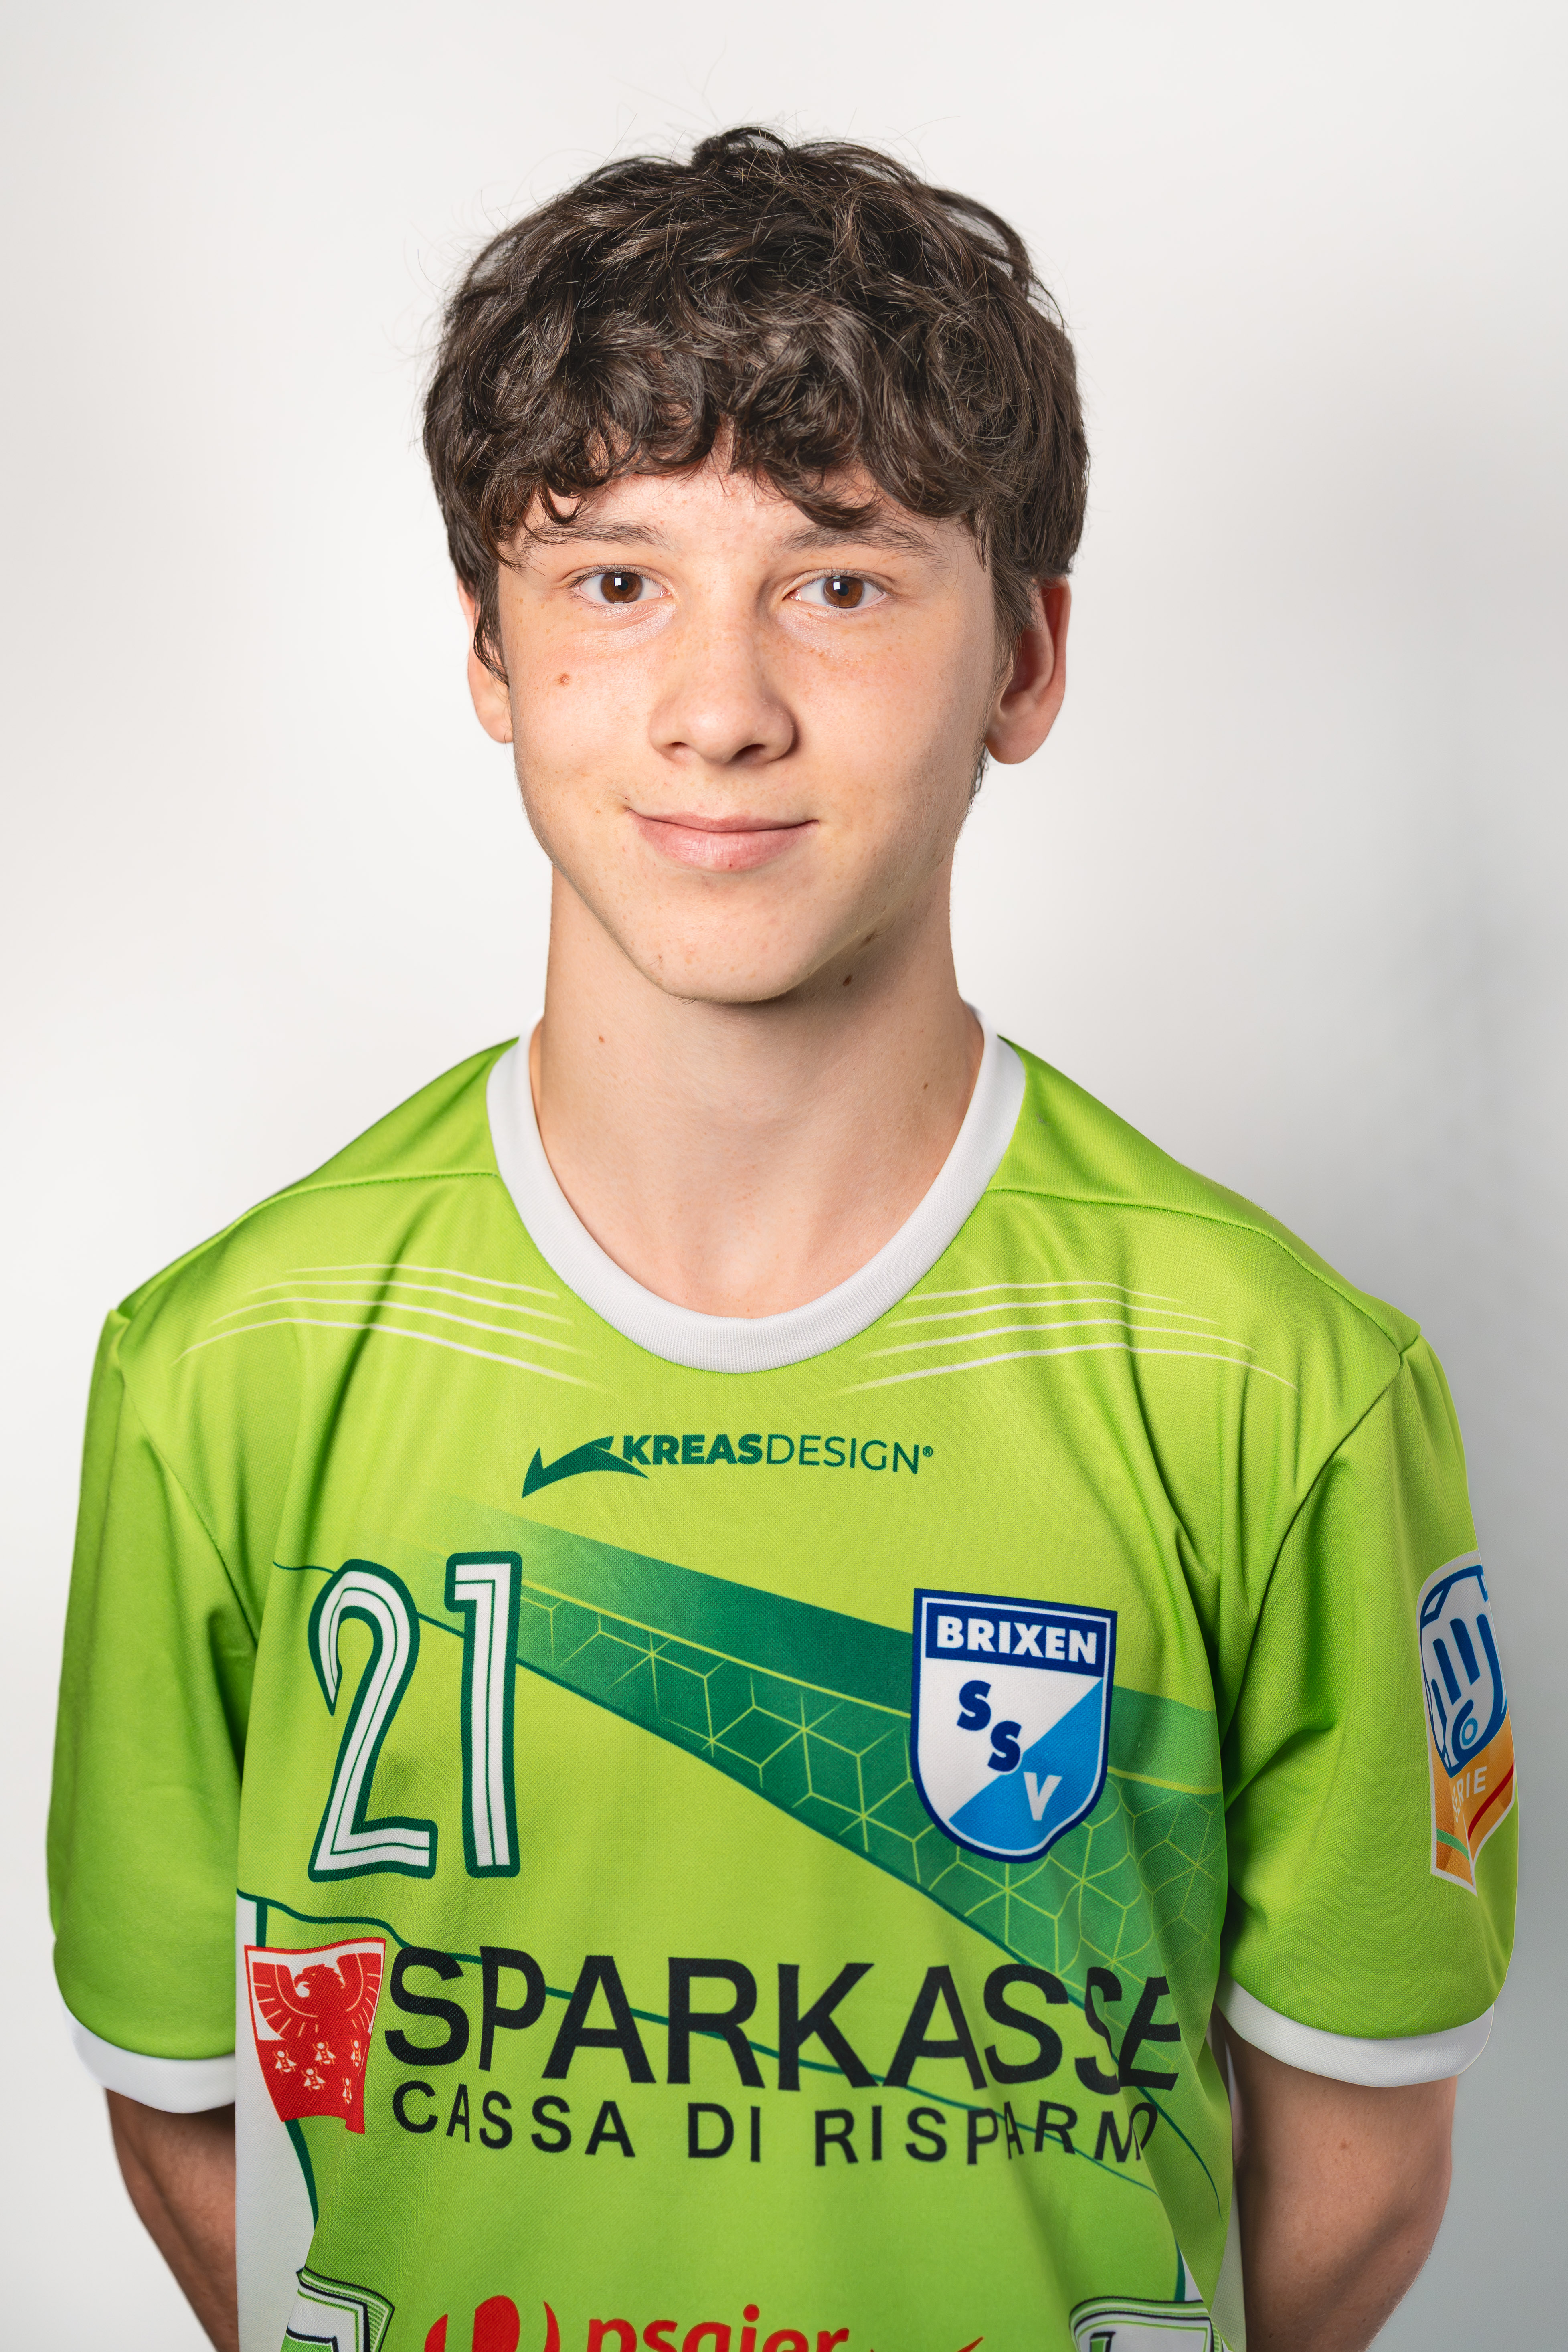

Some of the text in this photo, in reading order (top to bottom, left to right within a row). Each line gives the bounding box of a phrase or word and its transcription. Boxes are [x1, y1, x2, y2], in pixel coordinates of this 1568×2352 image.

[937, 1615, 1097, 1664] BRIXEN
[308, 1551, 522, 1883] 21
[1452, 1766, 1487, 1823] SERIE
[384, 1946, 1181, 2095] SPARKASSE
[392, 2081, 635, 2158] CASSA
[688, 2102, 761, 2163] DI
